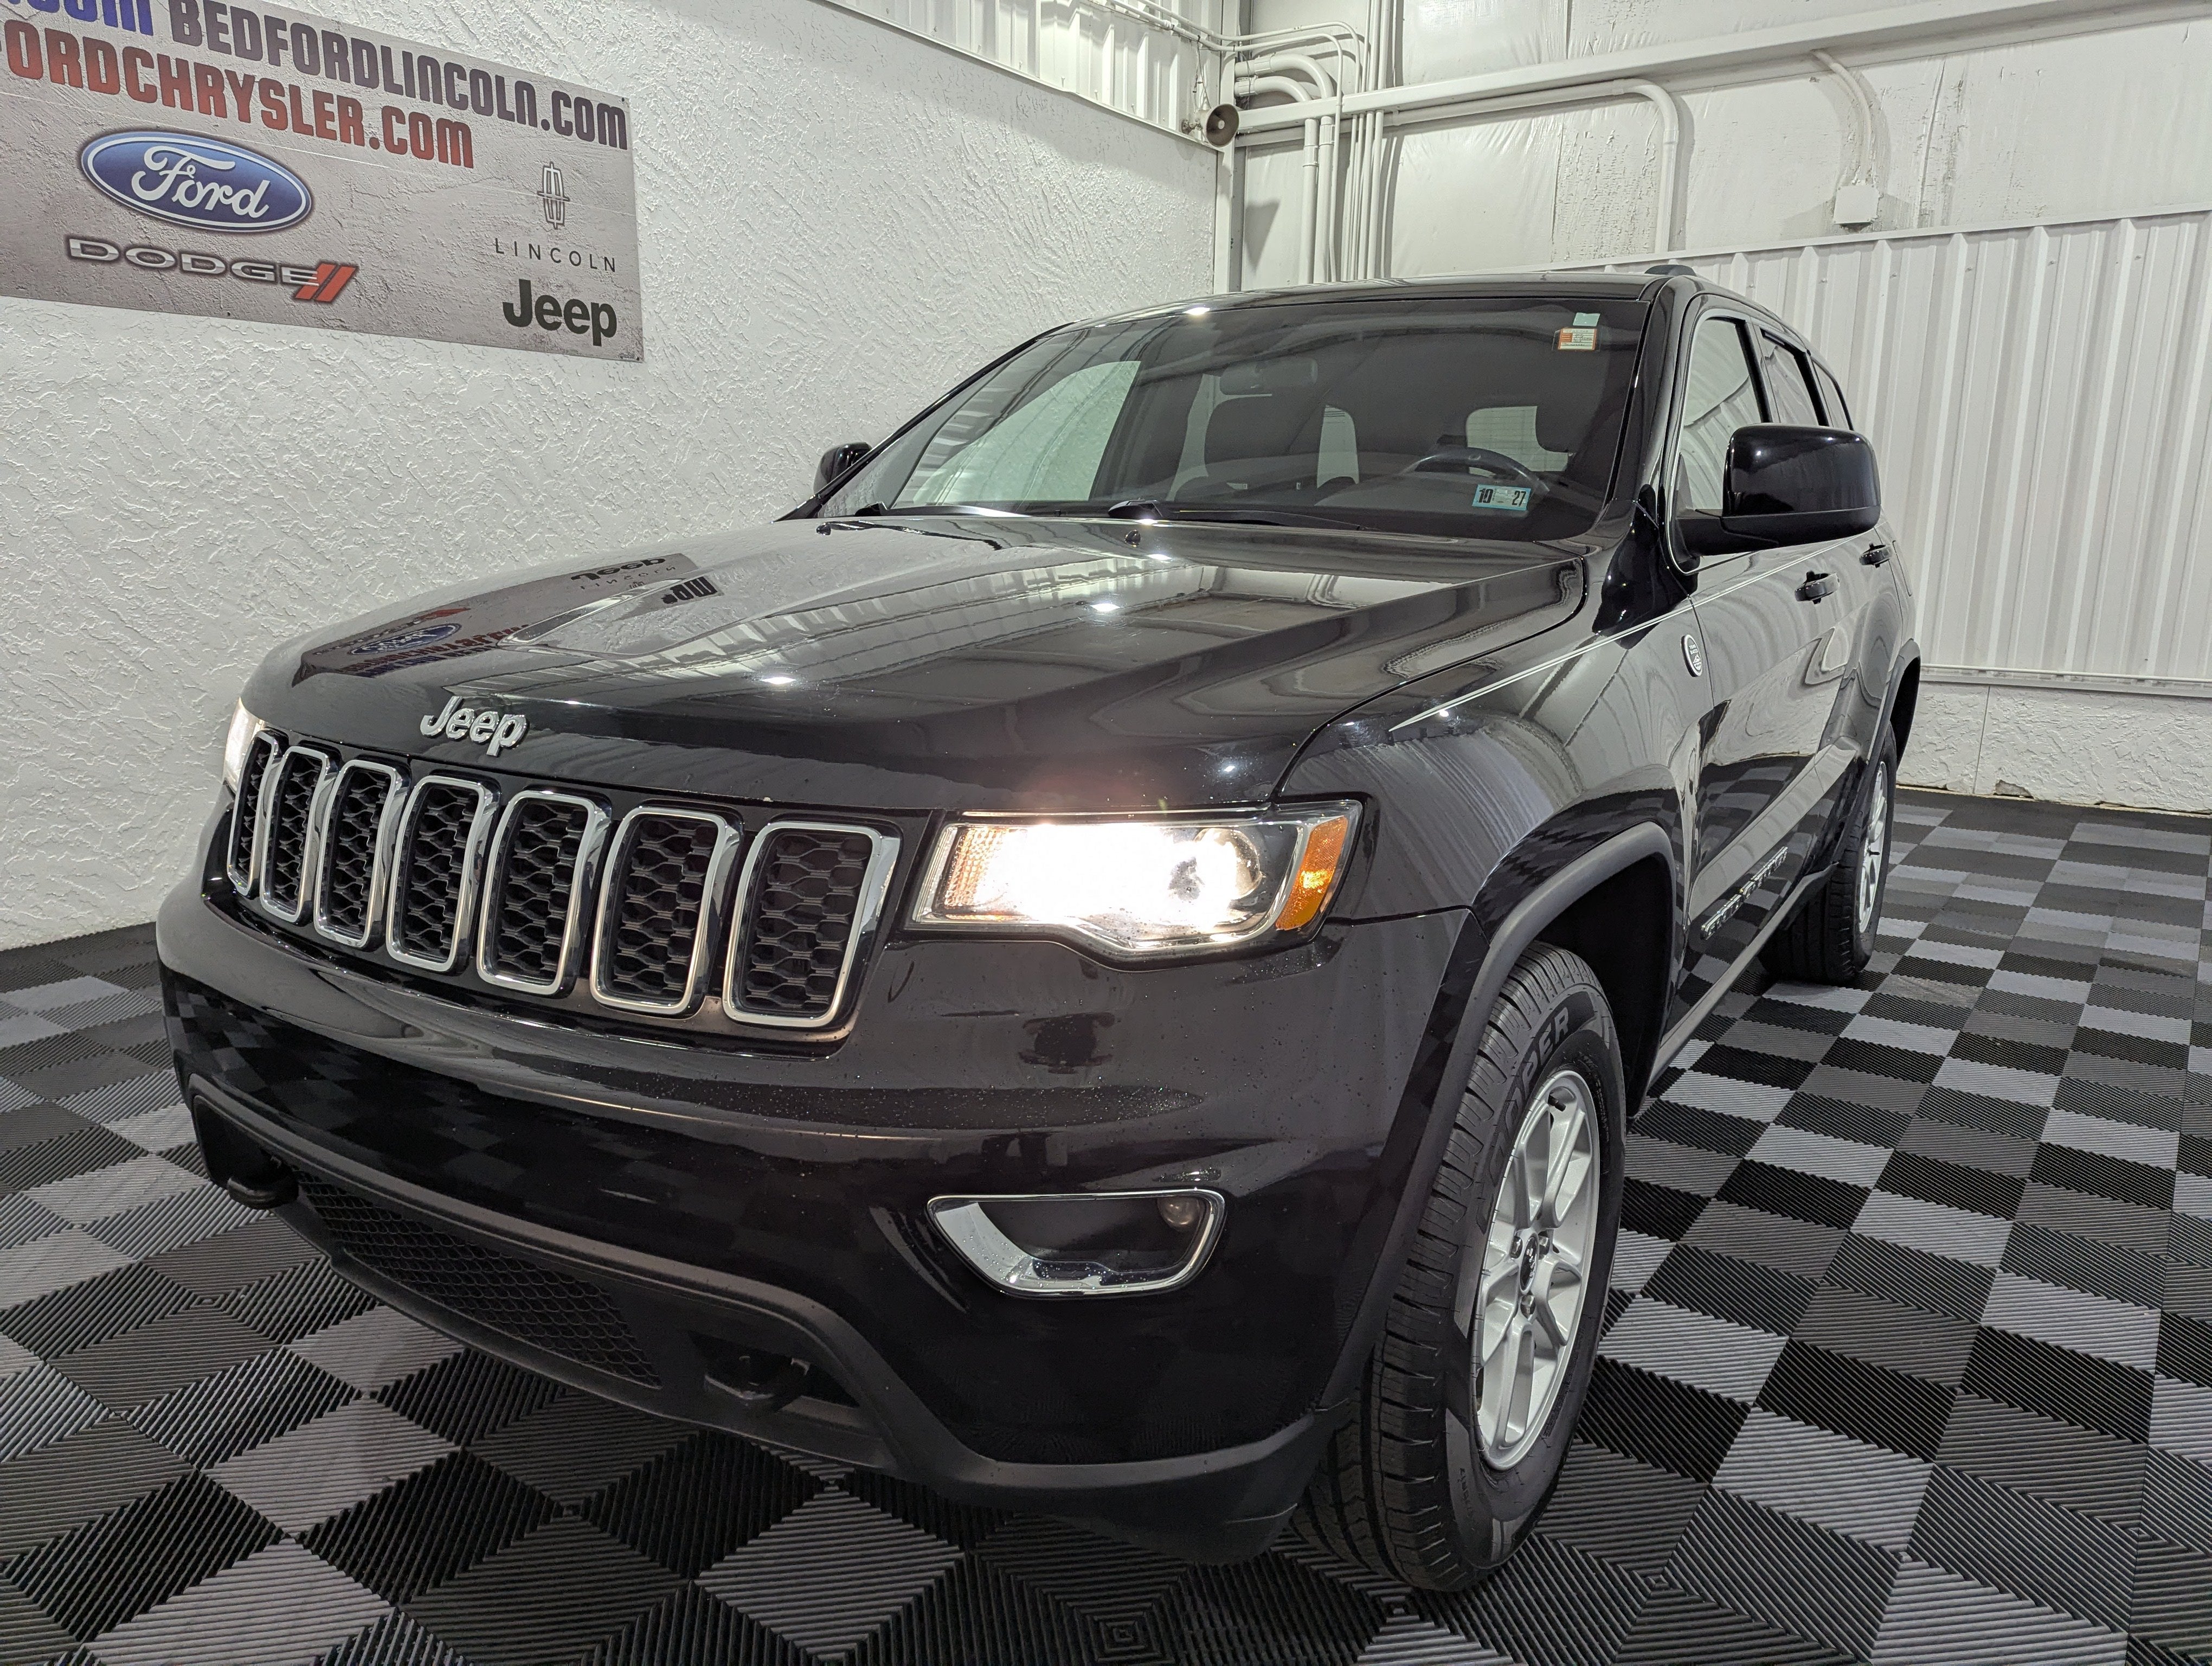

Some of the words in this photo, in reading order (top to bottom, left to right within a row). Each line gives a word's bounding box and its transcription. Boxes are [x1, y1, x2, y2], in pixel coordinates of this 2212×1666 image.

[0, 20, 474, 169] ORDCHRYSLER.COM
[132, 146, 270, 218] Ford
[69, 239, 319, 286] DODGE
[495, 238, 616, 272] LINCOLN
[502, 279, 617, 347] Jeep
[1478, 489, 1494, 503] 10
[1512, 490, 1527, 507] 27
[420, 696, 530, 757] Jeep
